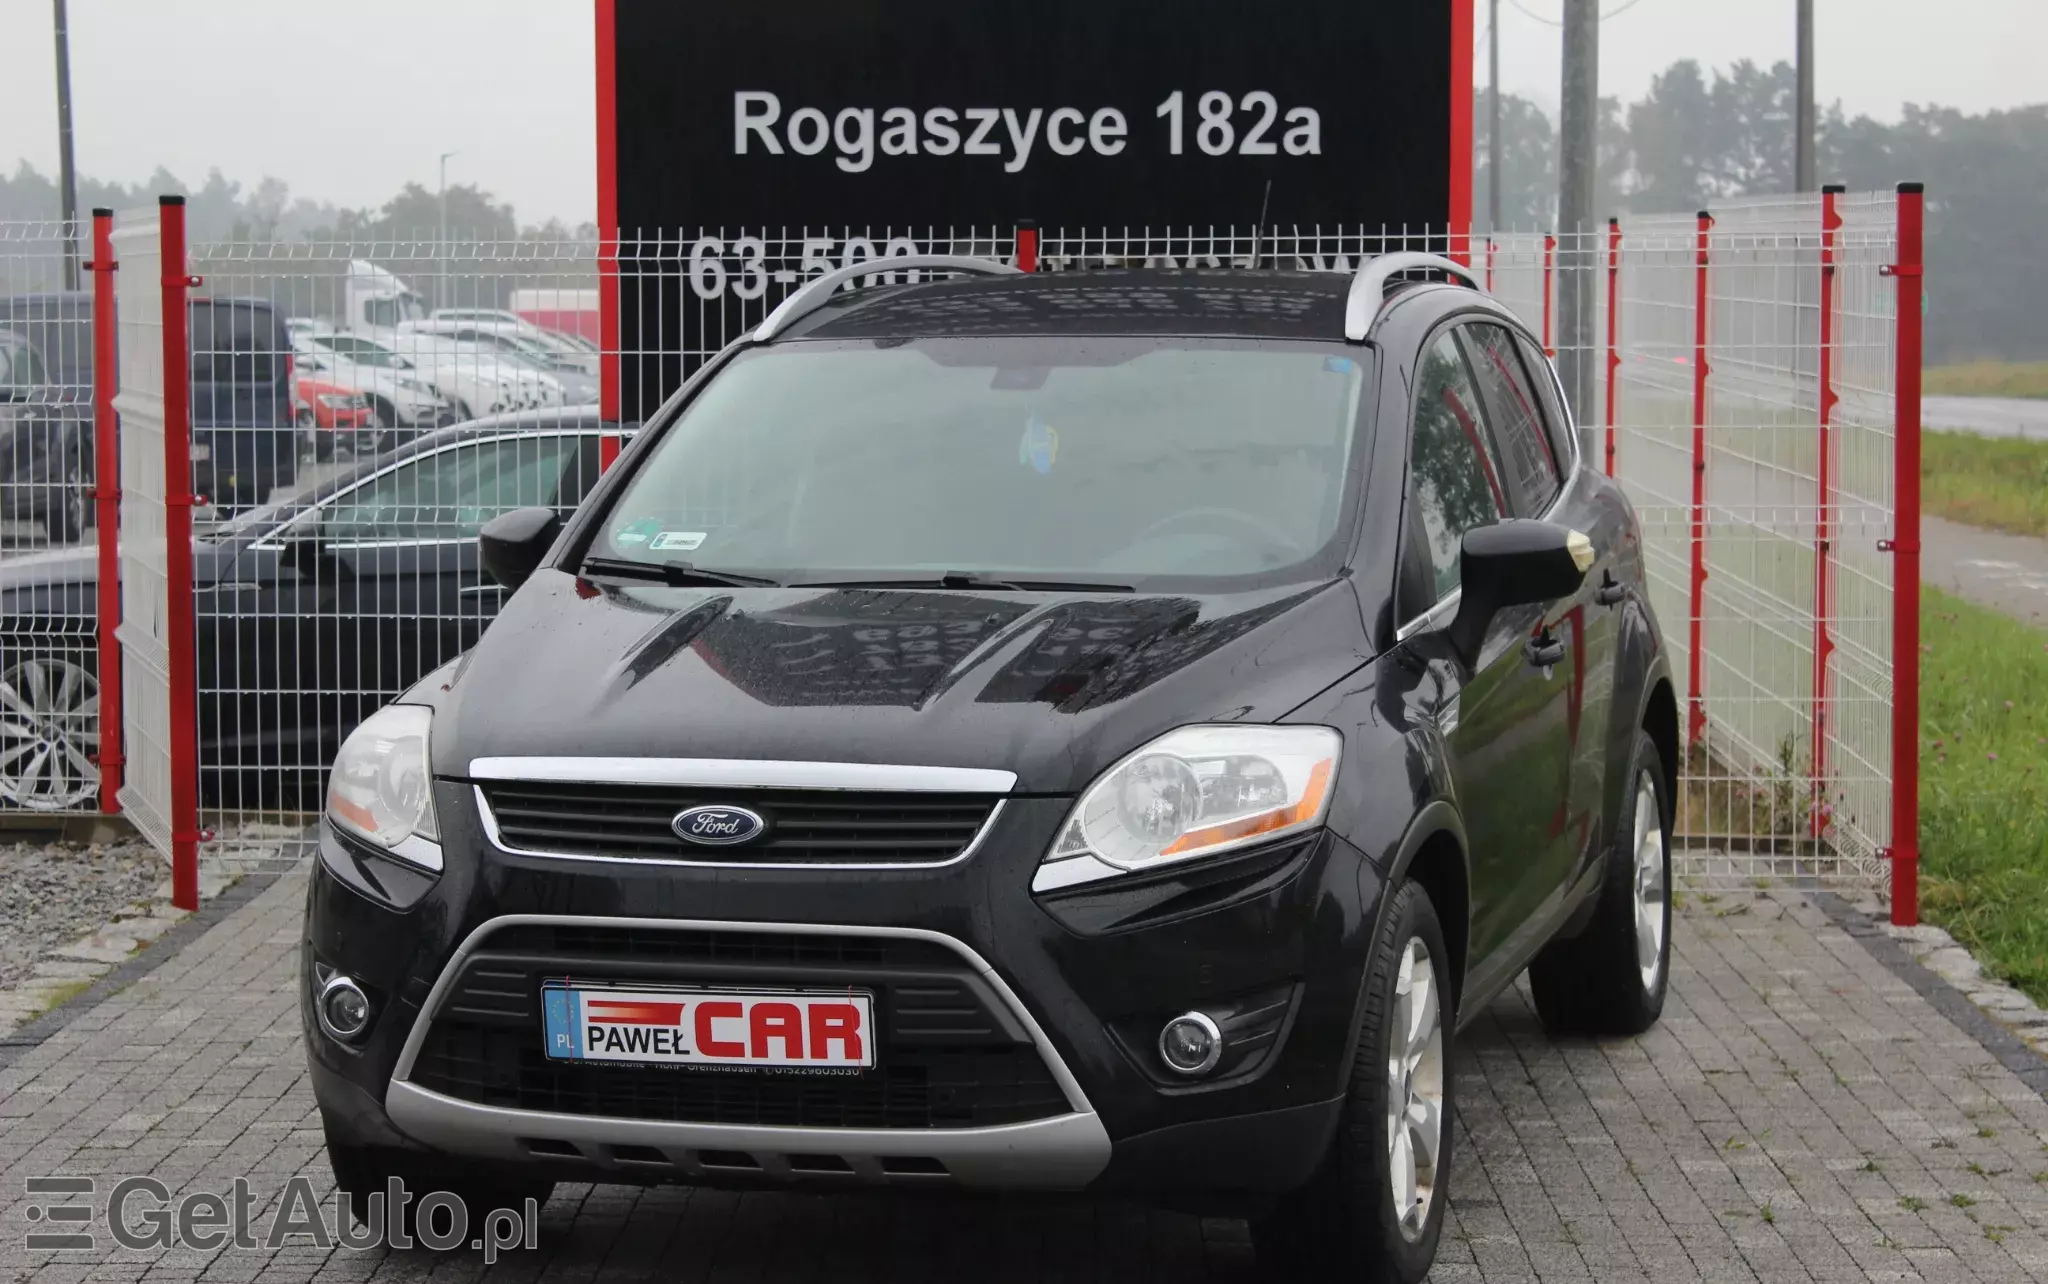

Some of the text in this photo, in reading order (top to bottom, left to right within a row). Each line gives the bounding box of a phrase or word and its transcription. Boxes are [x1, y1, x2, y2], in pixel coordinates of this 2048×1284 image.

[733, 91, 1321, 173] Rogaszyce 182a
[692, 813, 740, 833] Ford
[557, 1034, 574, 1049] PL
[587, 1002, 862, 1059] PAWEŁ CAR
